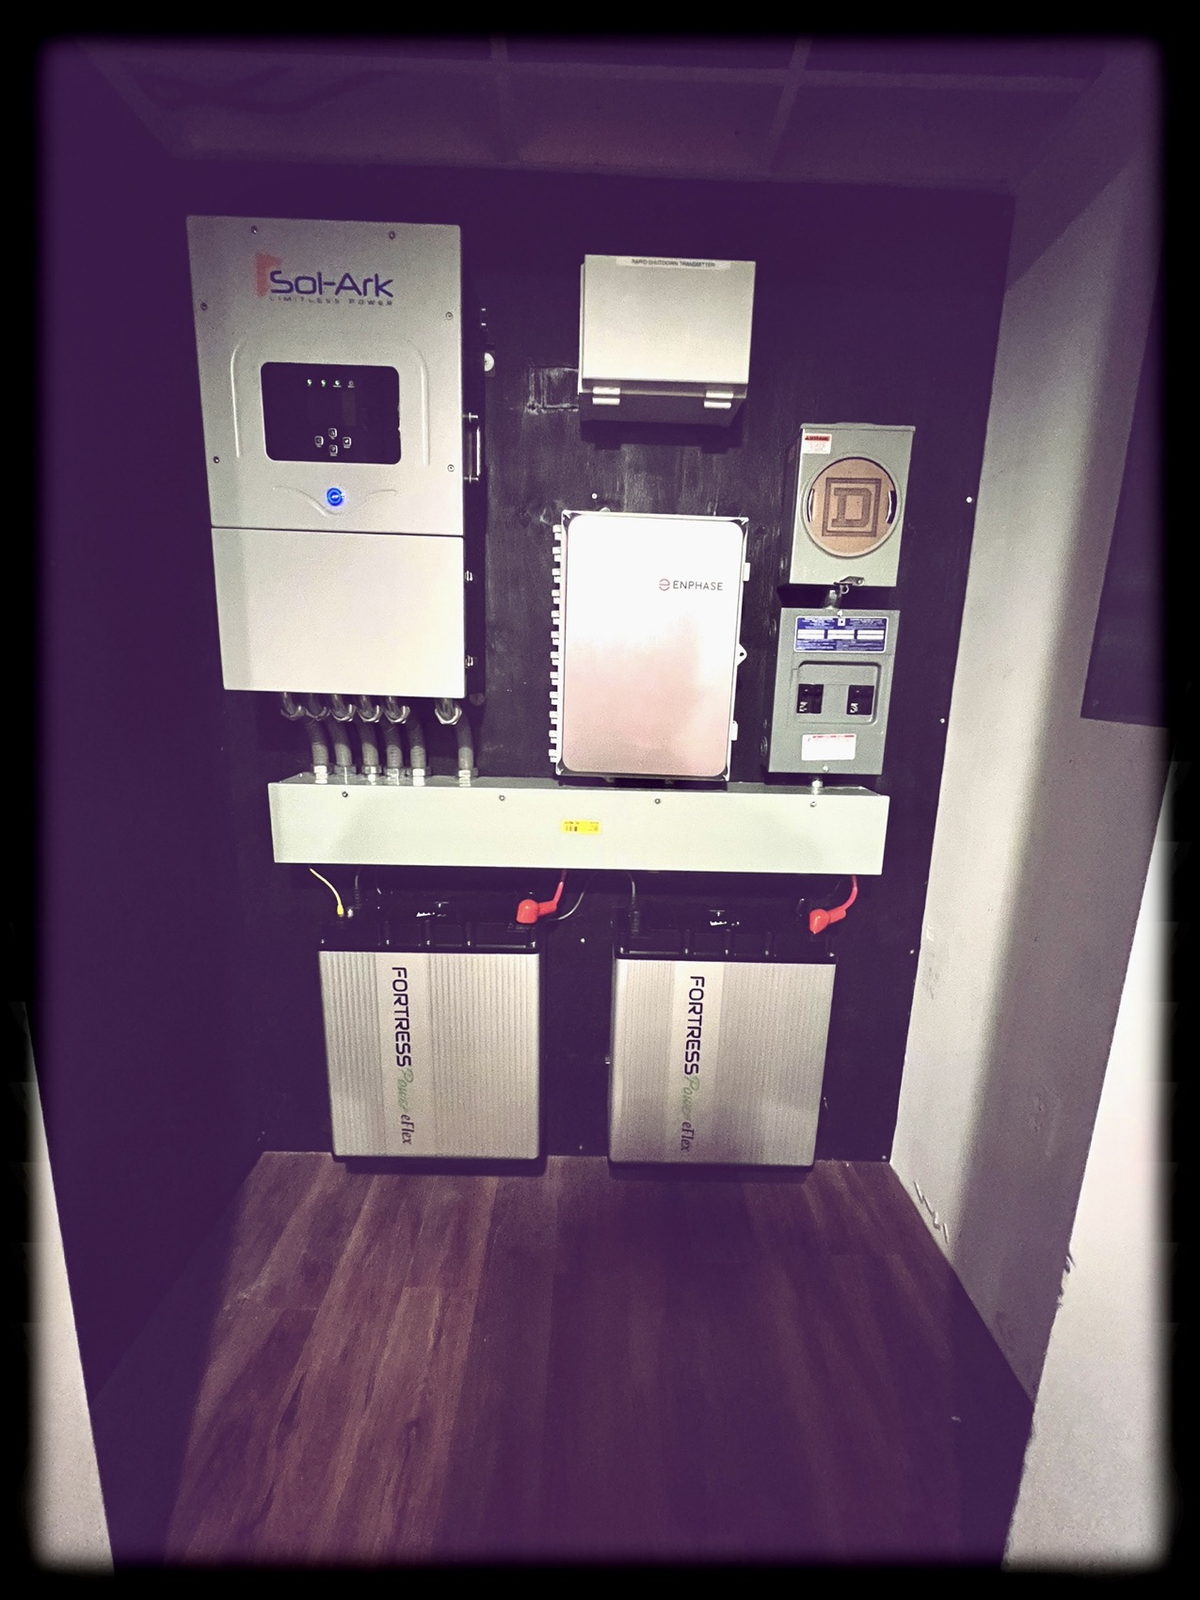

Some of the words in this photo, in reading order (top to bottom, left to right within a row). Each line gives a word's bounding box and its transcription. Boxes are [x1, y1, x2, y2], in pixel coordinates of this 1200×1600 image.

[270, 270, 394, 298] Sol-Ark
[269, 296, 340, 305] LIMITLESS
[348, 298, 393, 306] POWER
[672, 580, 724, 591] ENPHASE
[391, 966, 412, 1068] FORTRESS
[684, 975, 706, 1076] FORTRESS
[400, 1114, 415, 1146] eFlex
[680, 1121, 695, 1153] eFlex
